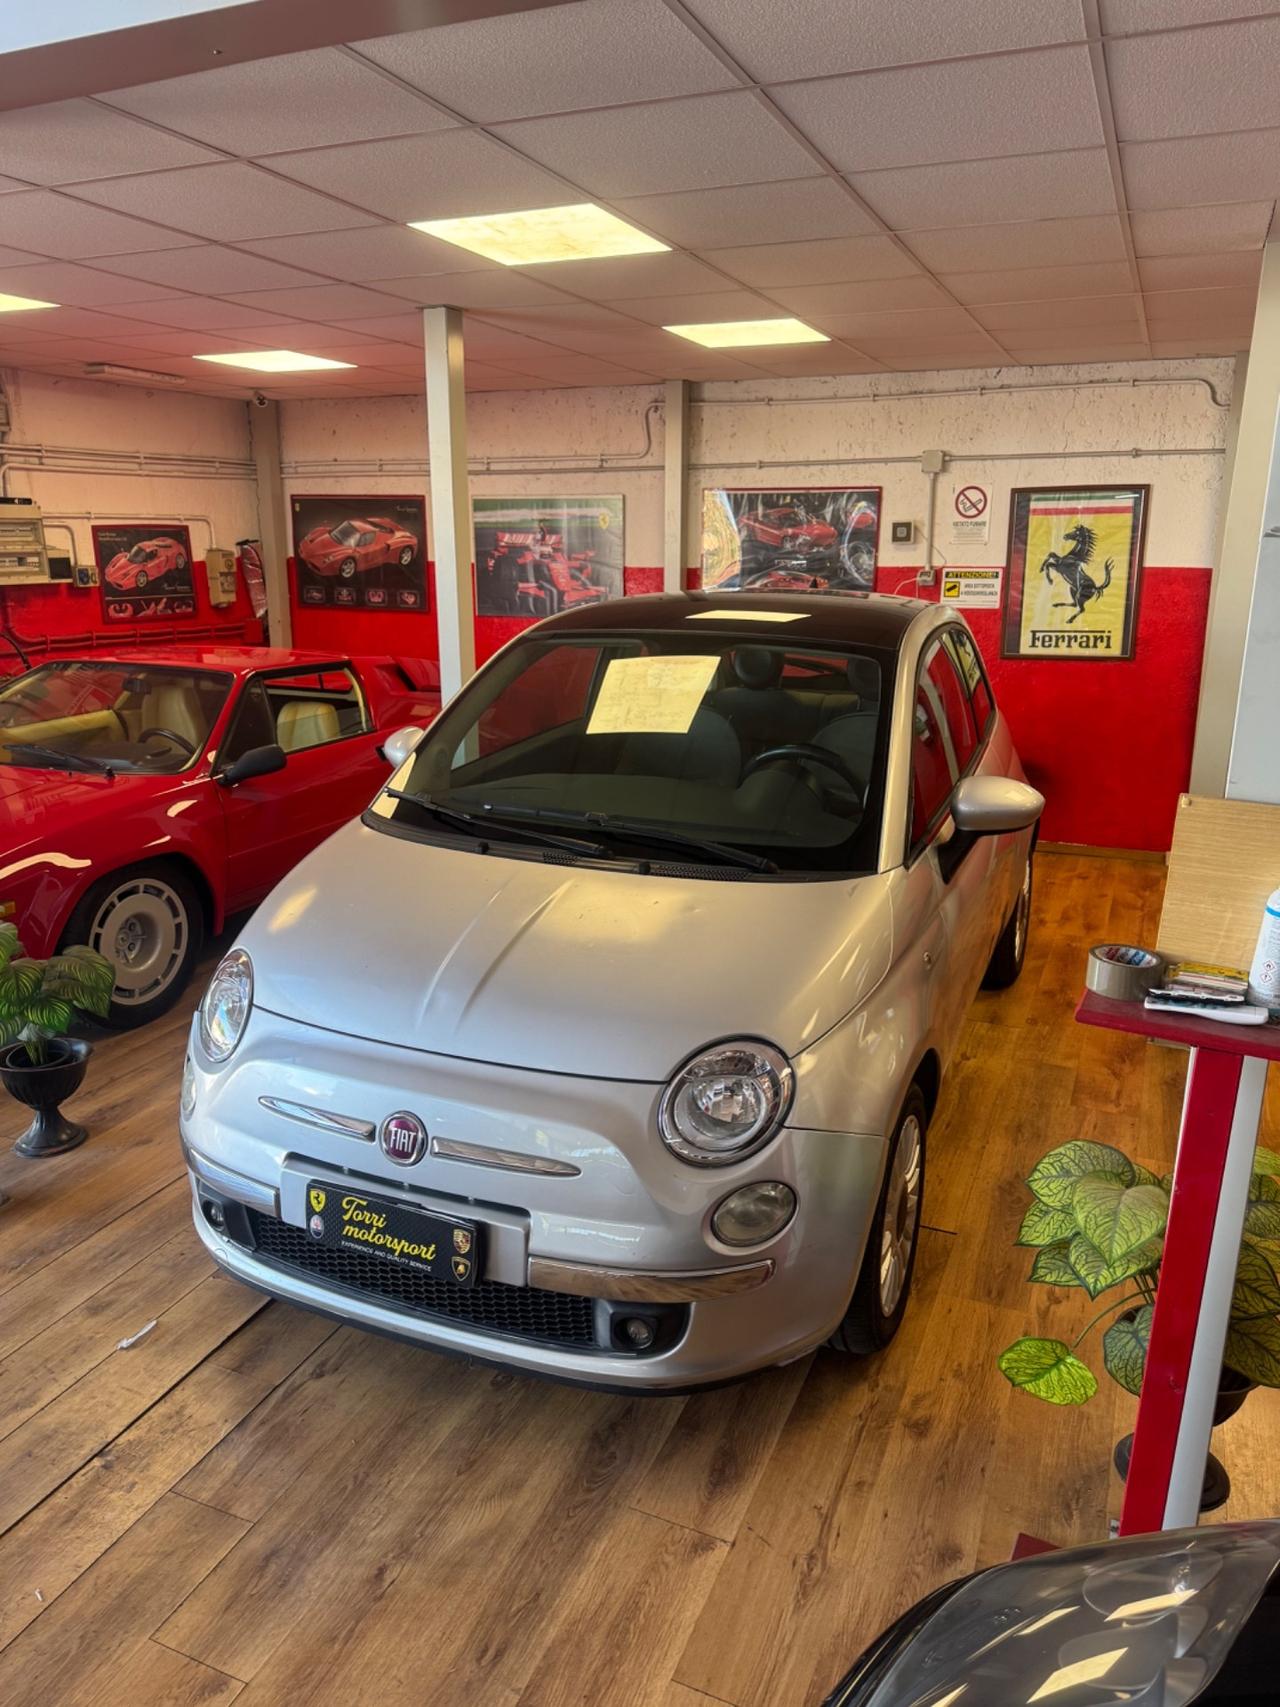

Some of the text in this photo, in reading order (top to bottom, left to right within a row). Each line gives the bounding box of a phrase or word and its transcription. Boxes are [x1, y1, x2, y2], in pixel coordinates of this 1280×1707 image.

[1028, 629, 1112, 649] Ferrari
[389, 1127, 417, 1153] FIAT
[341, 1196, 387, 1229] Torri
[342, 1225, 436, 1261] motorsport
[374, 1250, 386, 1258] AND
[410, 1260, 432, 1272] SERVICE
